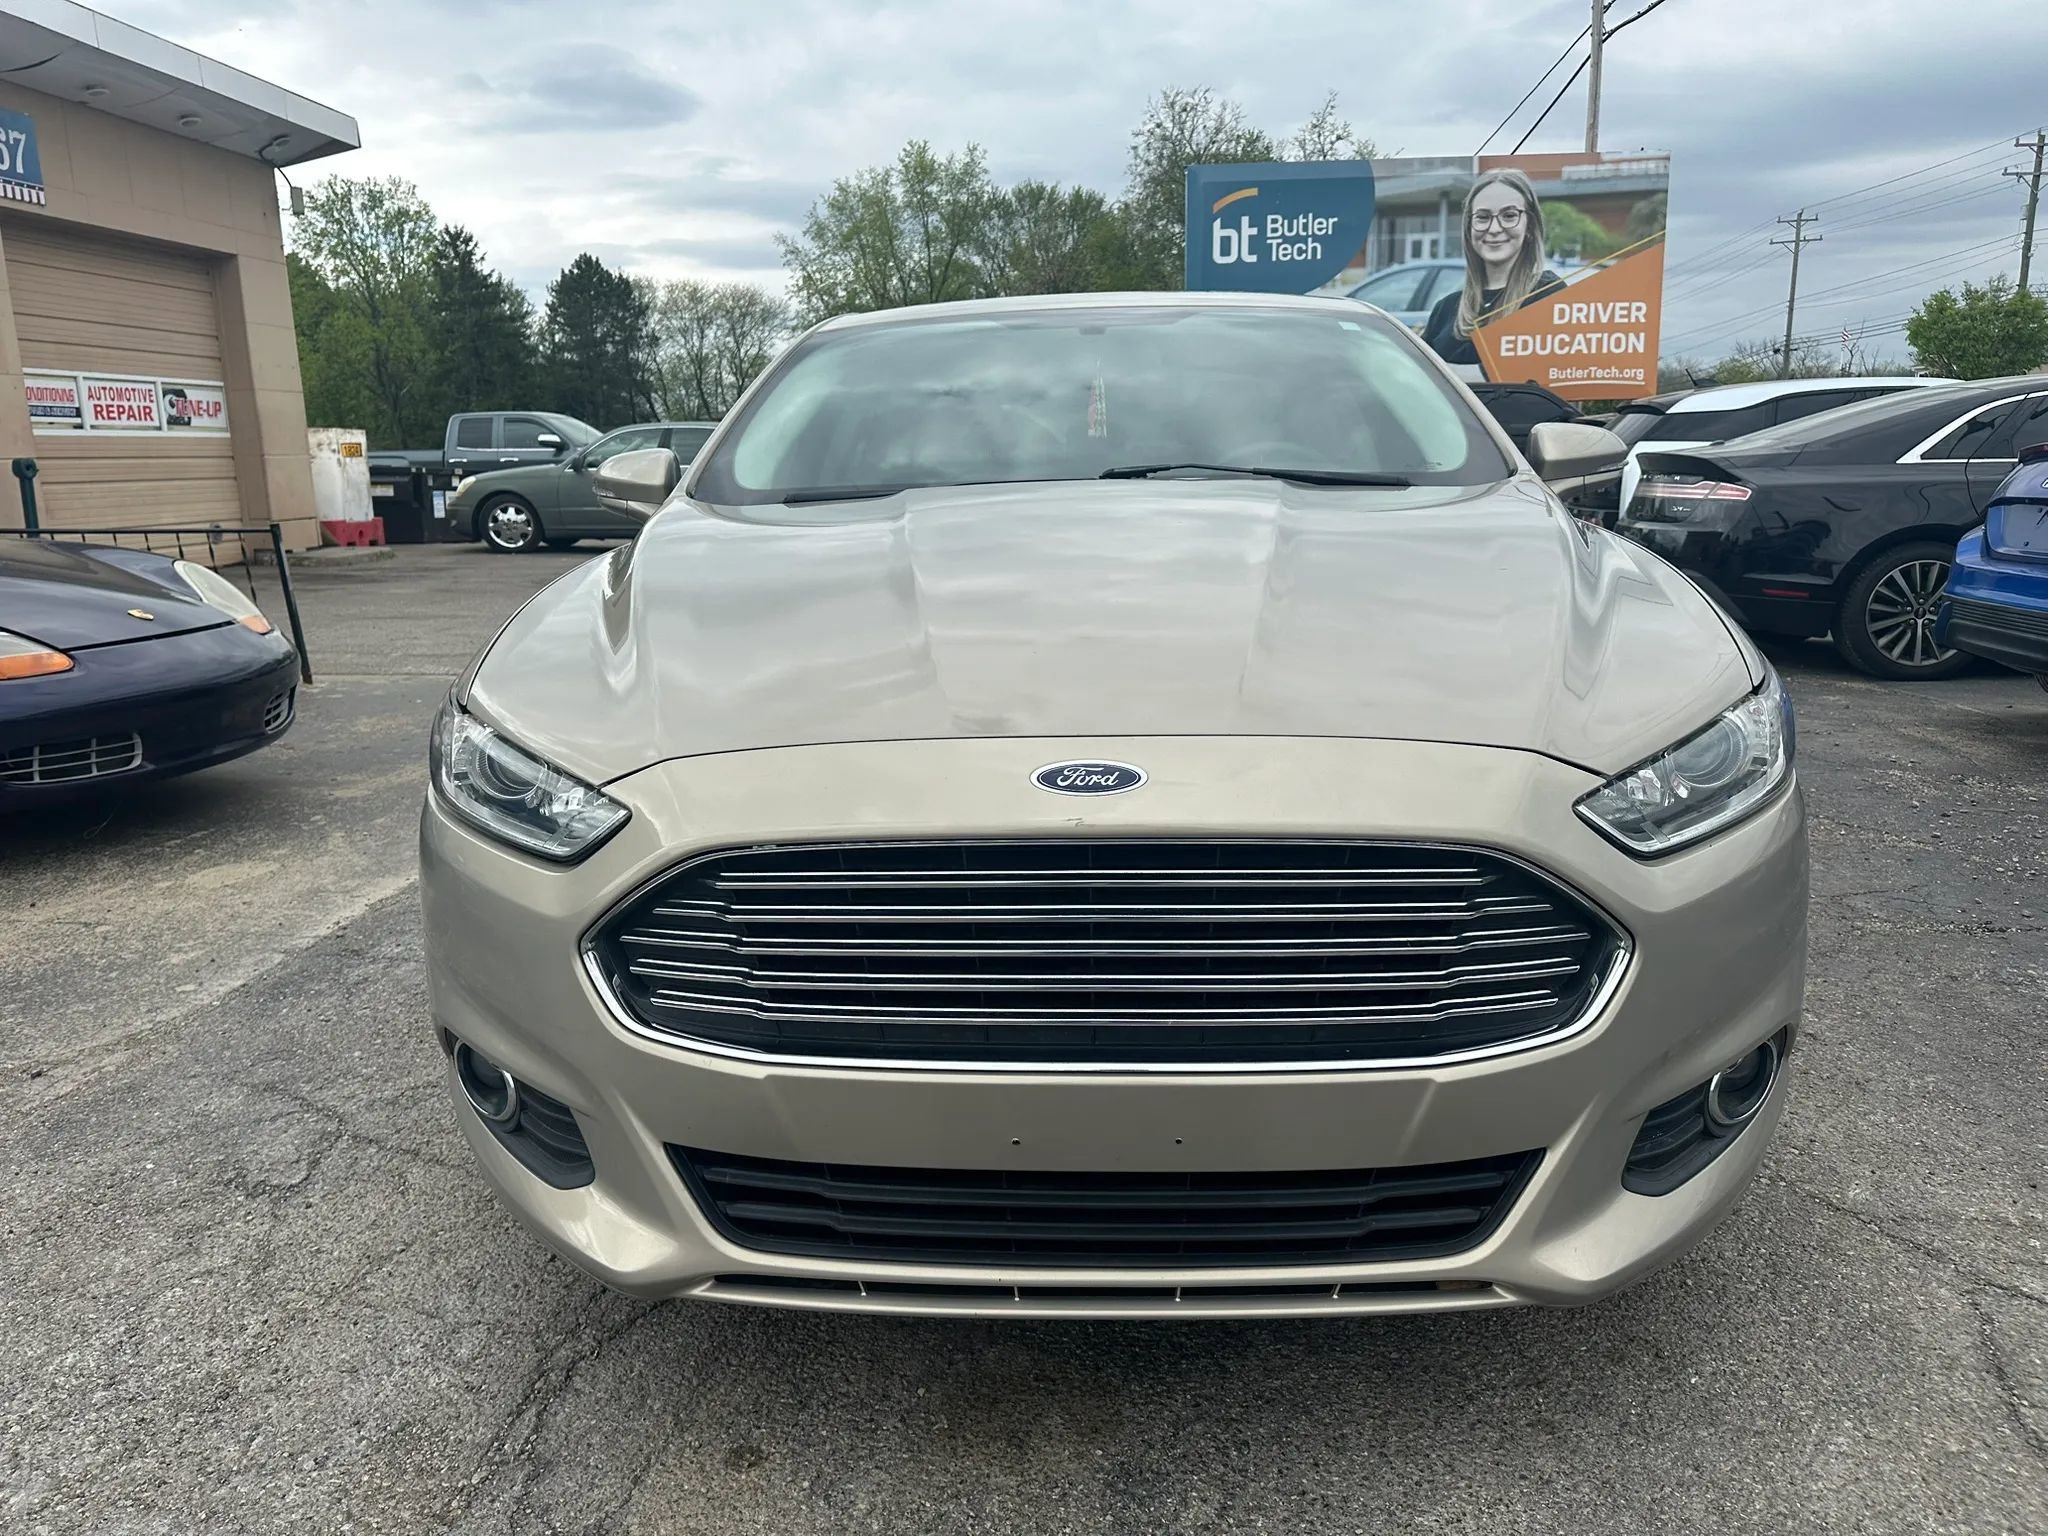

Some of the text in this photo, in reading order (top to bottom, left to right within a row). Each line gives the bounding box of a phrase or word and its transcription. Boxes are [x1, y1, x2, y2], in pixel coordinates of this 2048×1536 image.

[1266, 213, 1339, 238] Butler
[1212, 217, 1258, 264] bt
[1266, 237, 1322, 262] Tech
[1553, 302, 1648, 325] DRIVER
[1500, 332, 1646, 357] EDUCATION
[1548, 366, 1645, 381] ButlerTech.org
[25, 386, 76, 402] ONDITIONING
[87, 385, 155, 403] AUTOMOTIVE
[92, 403, 155, 422] REPAIR
[175, 399, 222, 418] TUNE-UP
[1056, 766, 1120, 787] Ford
